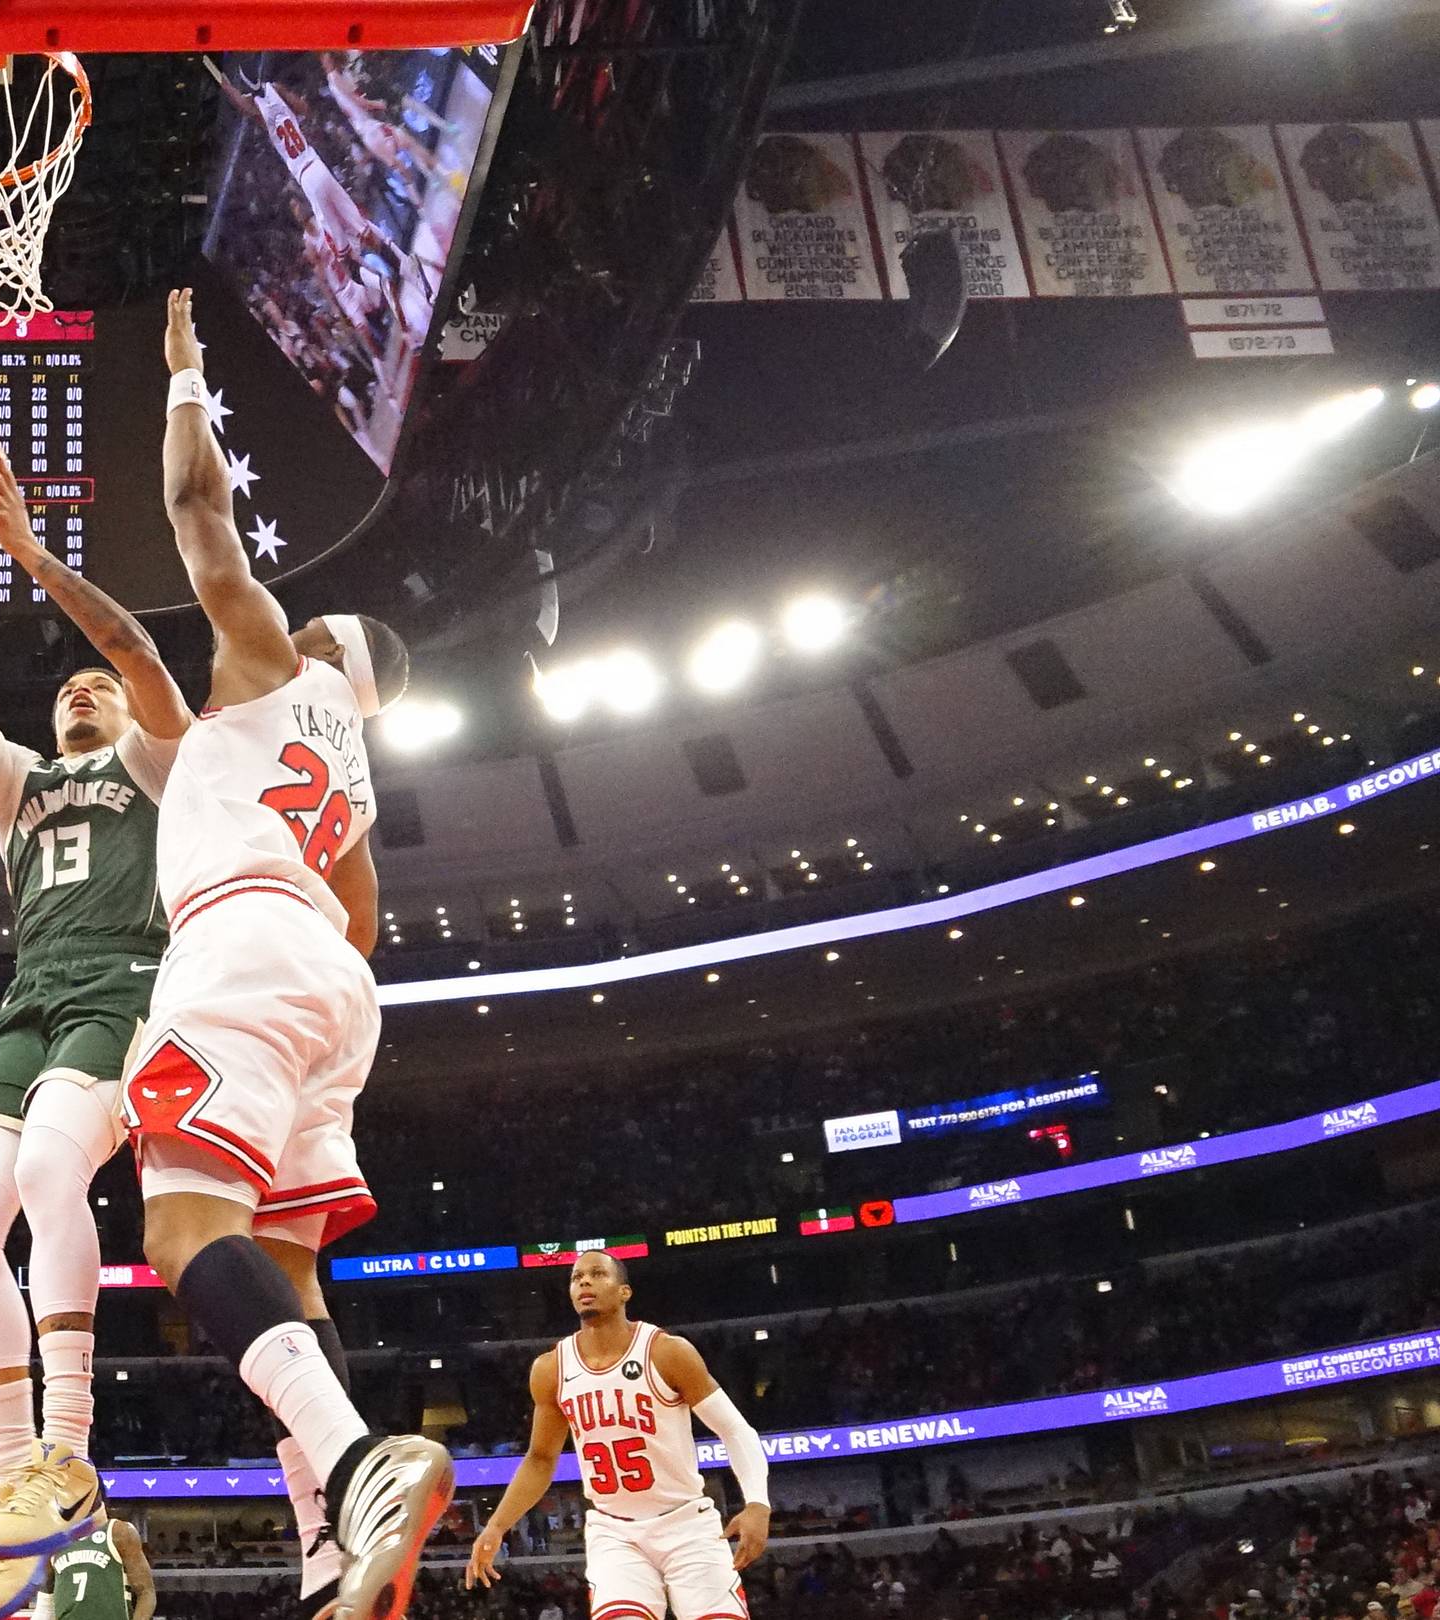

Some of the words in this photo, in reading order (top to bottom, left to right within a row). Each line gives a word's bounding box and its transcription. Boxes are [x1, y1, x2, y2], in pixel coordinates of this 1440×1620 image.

[46, 354, 60, 367] 0/0
[31, 387, 47, 401] 2/2
[66, 387, 82, 401] 0/0
[292, 704, 368, 815] YABUSELE
[16, 779, 136, 841] MILWAUKEE
[258, 741, 352, 881] 28
[1252, 797, 1337, 831] REHAB.
[38, 821, 91, 890] 13
[908, 1117, 936, 1129] TEXT
[1001, 1100, 1025, 1114] FOR
[1027, 1084, 1099, 1108] ASSISTANCE
[834, 1126, 854, 1136] FAN
[857, 1120, 892, 1133] ASSIST
[835, 1129, 893, 1144] PROGRAM
[665, 1227, 708, 1246] POINTS
[708, 1225, 720, 1240] IN
[720, 1222, 744, 1239] THE
[743, 1217, 777, 1236] PAINT
[362, 1258, 413, 1274] ULTRA
[430, 1253, 486, 1270] CLUB
[561, 1389, 656, 1440] BULLS
[850, 1418, 975, 1449] RENEWAL.
[582, 1436, 656, 1495] 35
[53, 1549, 111, 1575] MILWAUKEE
[72, 1572, 88, 1602] 7
